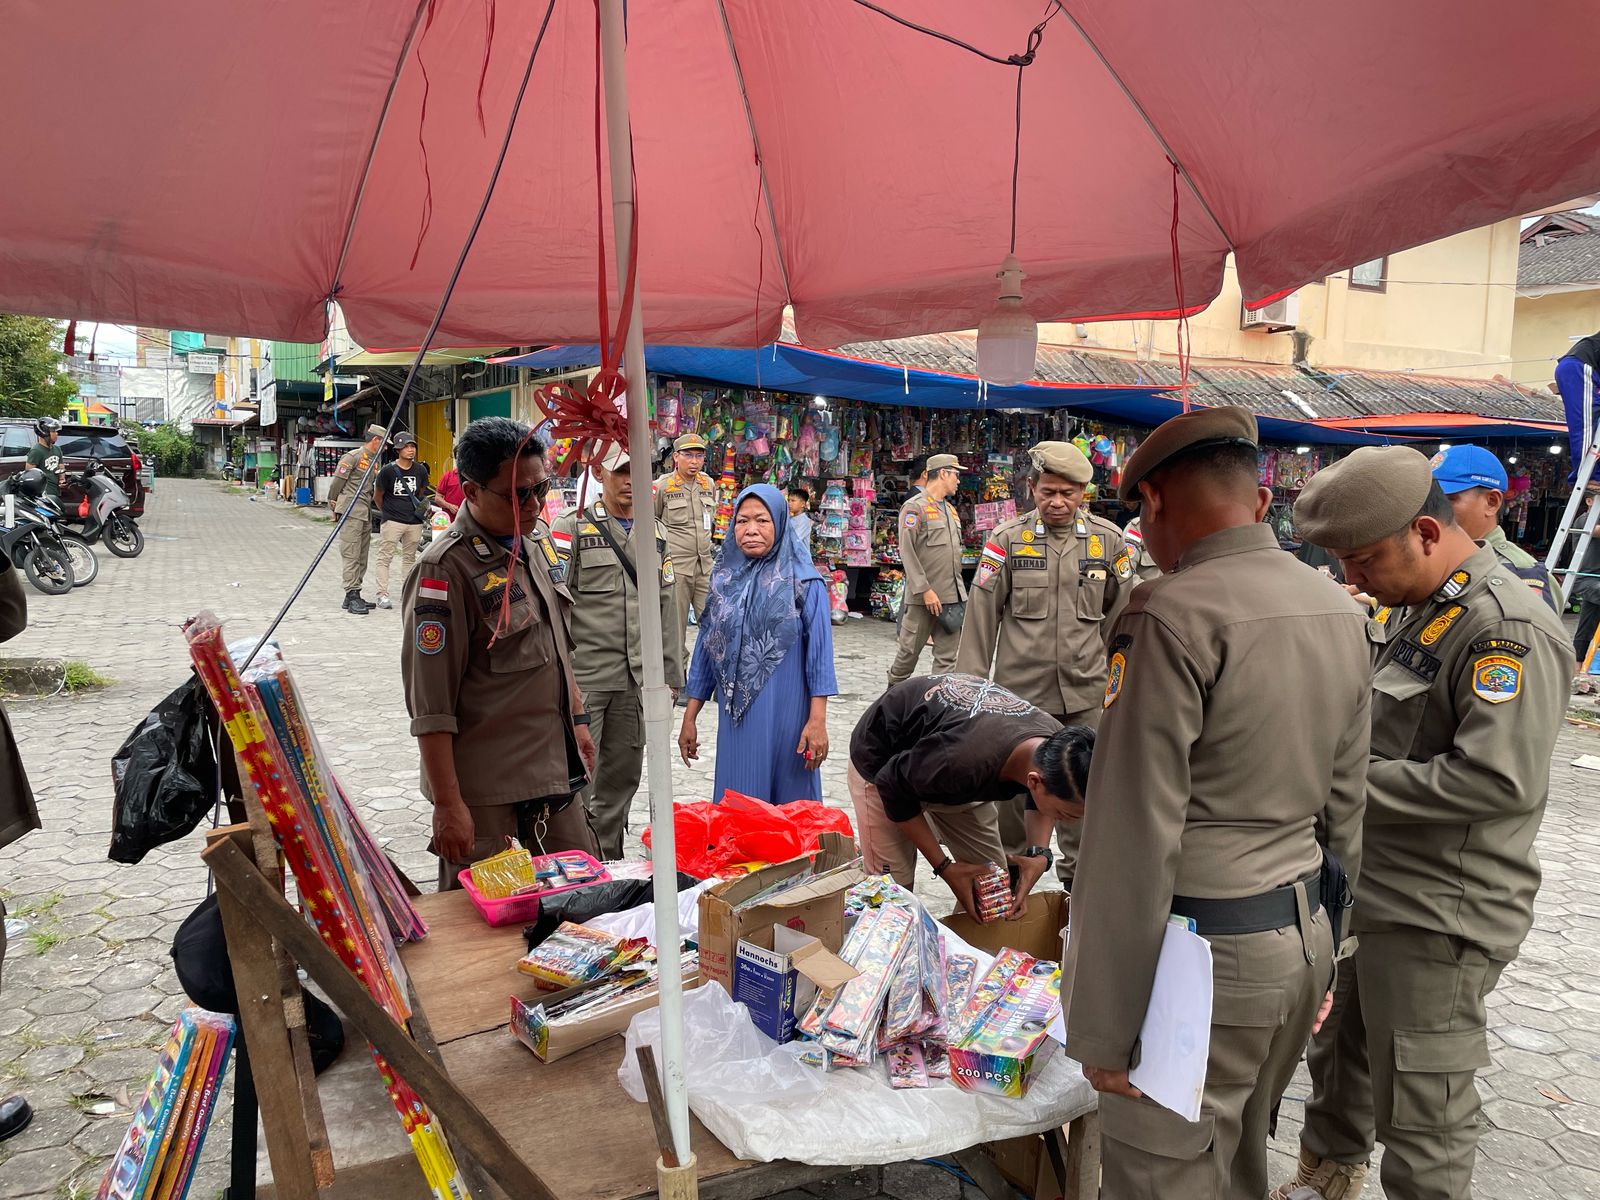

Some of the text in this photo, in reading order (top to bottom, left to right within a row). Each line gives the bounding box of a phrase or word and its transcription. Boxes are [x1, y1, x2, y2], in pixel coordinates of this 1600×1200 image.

[1013, 559, 1045, 568] AKHMAD
[739, 946, 778, 968] Hannochs
[957, 1066, 1011, 1083] 200 PCS
[192, 1089, 210, 1140] Best Quality
